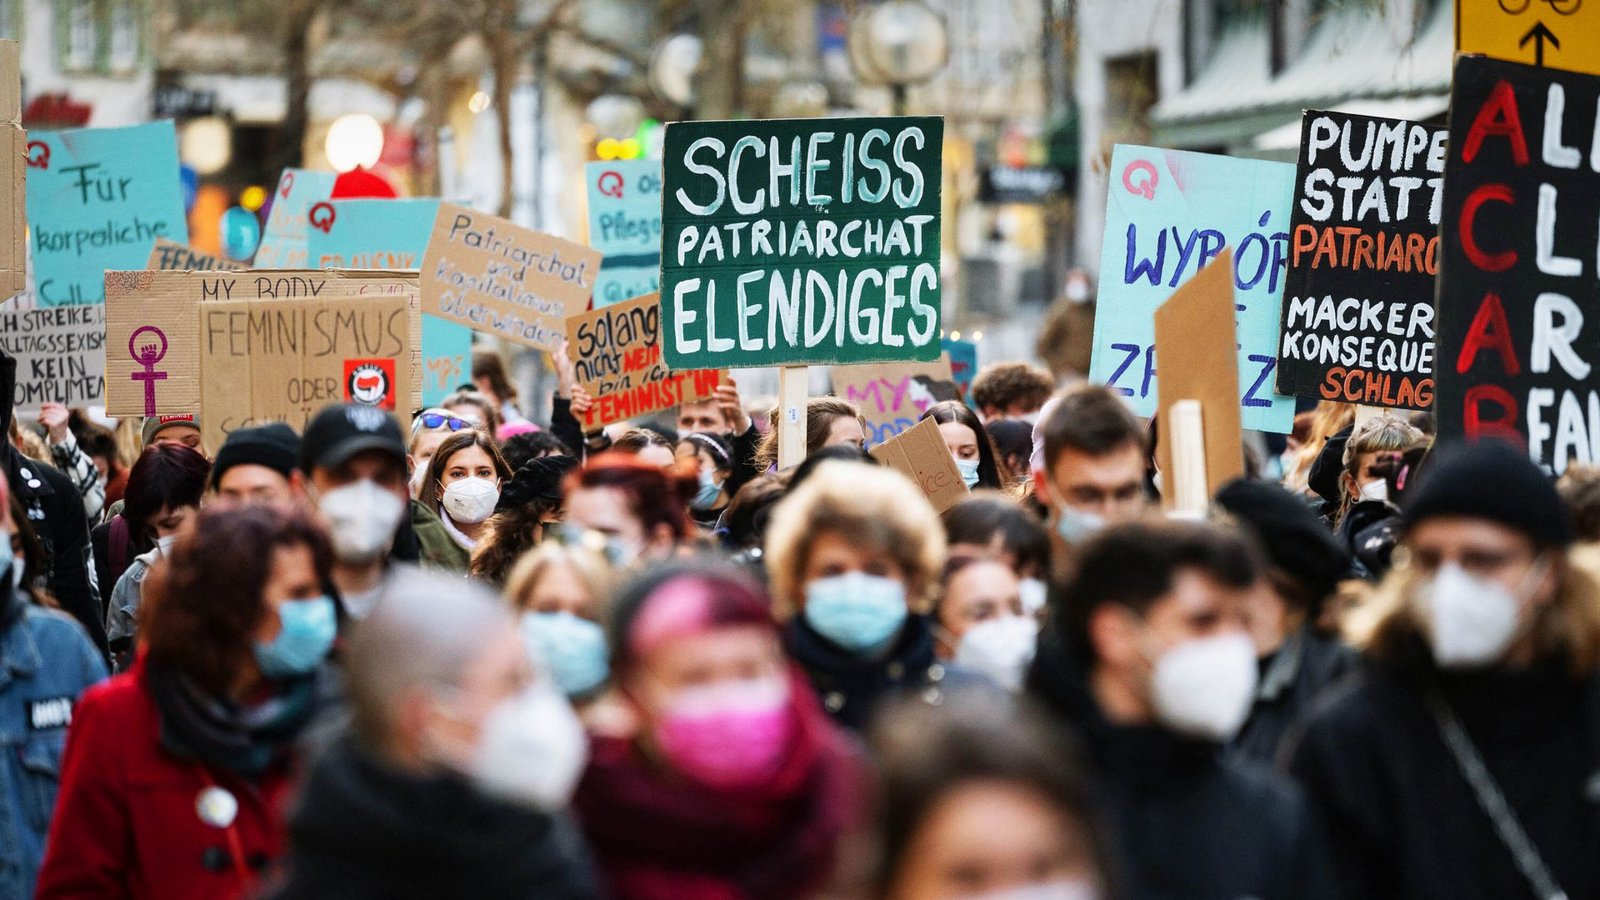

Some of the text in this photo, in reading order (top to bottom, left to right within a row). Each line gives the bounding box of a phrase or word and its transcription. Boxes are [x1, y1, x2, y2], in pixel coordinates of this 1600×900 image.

[25, 140, 51, 170] Q
[1308, 115, 1449, 173] PUMPE
[59, 163, 132, 204] Für
[598, 170, 624, 199] Q
[676, 126, 926, 216] SCHEISS
[1122, 159, 1159, 201] Q
[1300, 167, 1445, 225] STATT
[308, 201, 336, 234] Q
[677, 214, 935, 267] PATRIARCHAT
[1293, 223, 1440, 277] PATRIARC
[202, 278, 236, 300] MY
[673, 262, 938, 355] ELENDIGES
[205, 308, 405, 358] FEMINISMUS
[1287, 294, 1436, 339] MACKER
[31, 355, 87, 379] KEIN
[1282, 330, 1436, 374] KONSEQUE
[286, 377, 340, 405] ODER
[599, 374, 630, 398] bin
[846, 373, 911, 414] MY
[1320, 366, 1435, 408] SCHLAG
